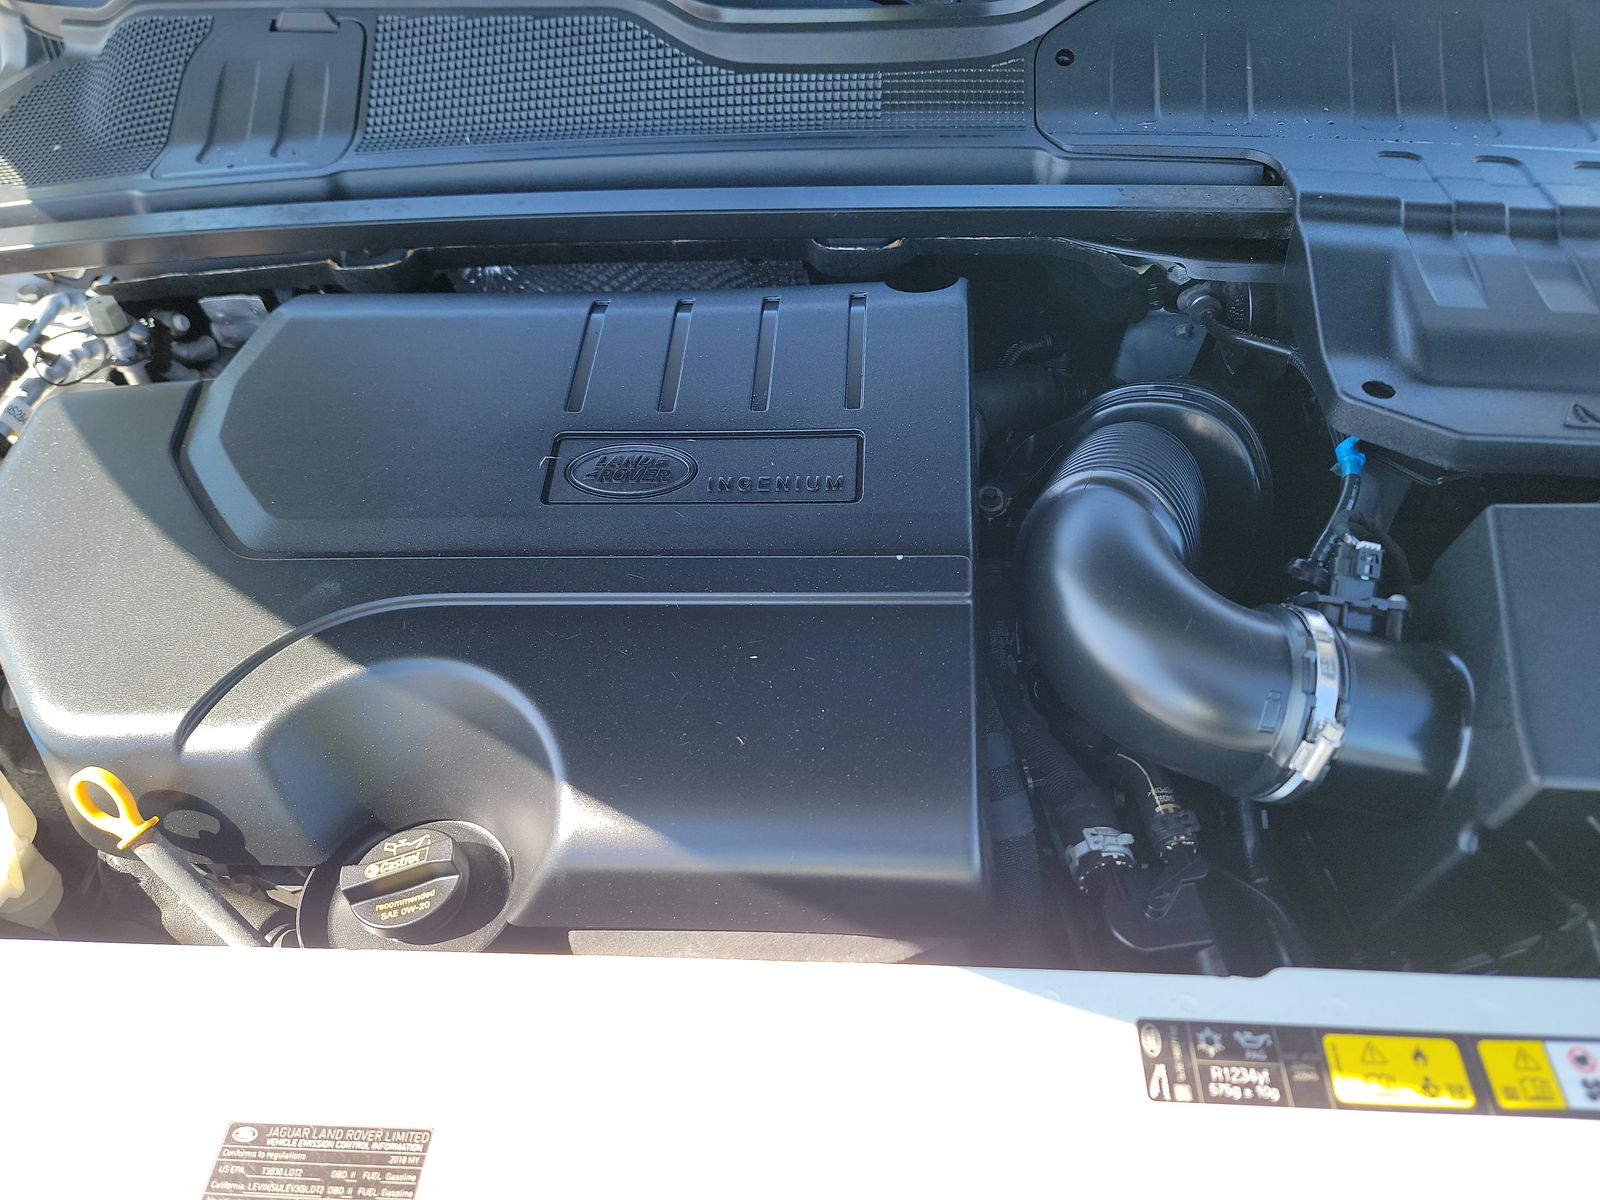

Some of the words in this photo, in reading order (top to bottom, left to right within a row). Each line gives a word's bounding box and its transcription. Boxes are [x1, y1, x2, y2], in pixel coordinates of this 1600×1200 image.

[594, 454, 653, 468] LAND
[597, 467, 673, 484] ROVER
[706, 474, 845, 494] INGENIUM
[379, 852, 420, 872] Castrol
[375, 888, 436, 912] recommended
[380, 910, 399, 921] SAE
[400, 900, 431, 916] 0W-20
[265, 1127, 310, 1139] JAGUAR
[311, 1128, 344, 1140] LAND
[345, 1129, 383, 1141] ROVER
[384, 1131, 430, 1144] LIMITED
[266, 1138, 297, 1147] VEHICLE
[297, 1140, 335, 1149] EMISSION
[335, 1141, 370, 1150] CONTROL
[371, 1142, 424, 1152] INFORMATION
[222, 1149, 257, 1158] Conforms
[257, 1150, 266, 1159] to
[266, 1151, 307, 1161] regulations
[407, 1157, 421, 1165] MY
[218, 1165, 231, 1173] US
[230, 1166, 246, 1174] EPA
[330, 1170, 348, 1179] OBD
[362, 1171, 382, 1181] FUEL
[385, 1172, 417, 1182] Gasoline
[210, 1180, 245, 1190] California
[326, 1186, 345, 1195] OBD
[357, 1187, 377, 1196] FUEL
[380, 1188, 414, 1198] Gasoline
